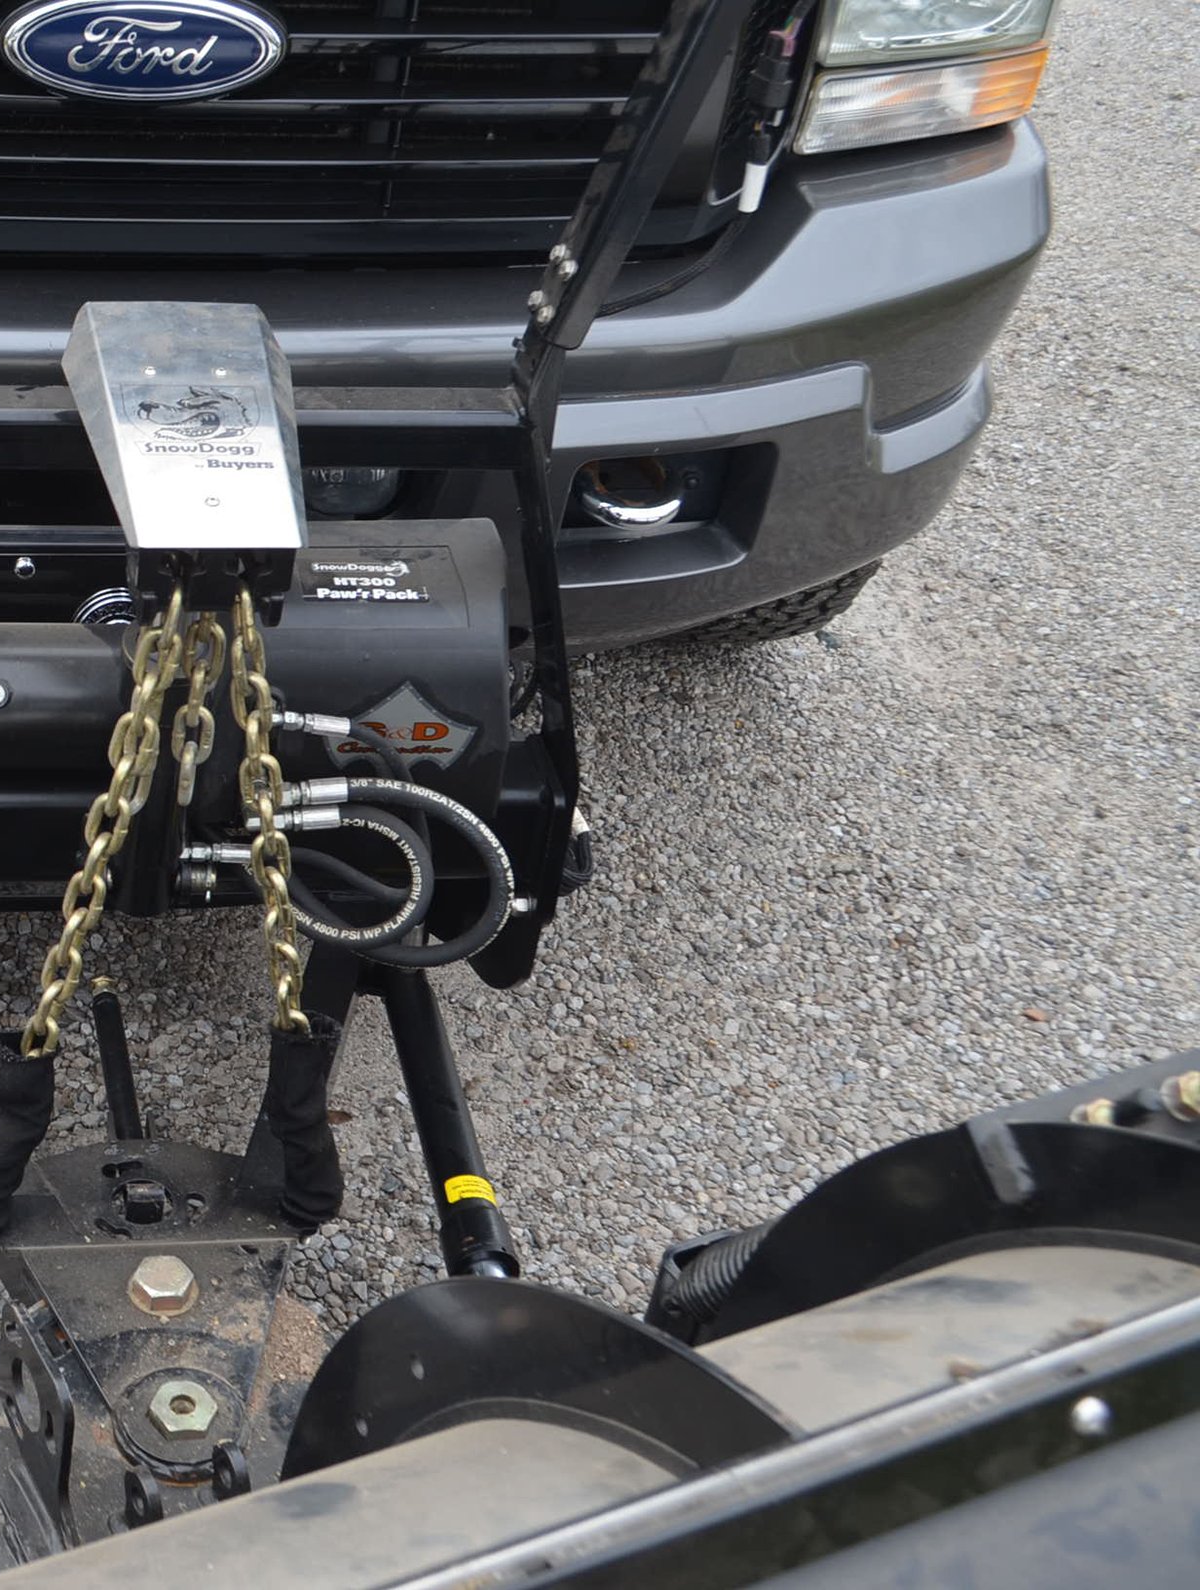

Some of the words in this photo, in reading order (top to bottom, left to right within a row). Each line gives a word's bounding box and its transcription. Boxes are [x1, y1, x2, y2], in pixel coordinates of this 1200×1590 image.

[68, 16, 219, 76] Ford
[144, 442, 255, 455] SnowDogg
[207, 459, 275, 470] Buyers
[372, 589, 420, 600] Pack
[376, 779, 402, 790] SAE
[478, 823, 500, 848] 4800
[367, 820, 400, 841] MSHA
[396, 840, 422, 900] RESISTANT
[383, 900, 417, 932] FLAME
[312, 921, 340, 937] 4800
[340, 929, 360, 940] PSI
[363, 928, 382, 939] WP
